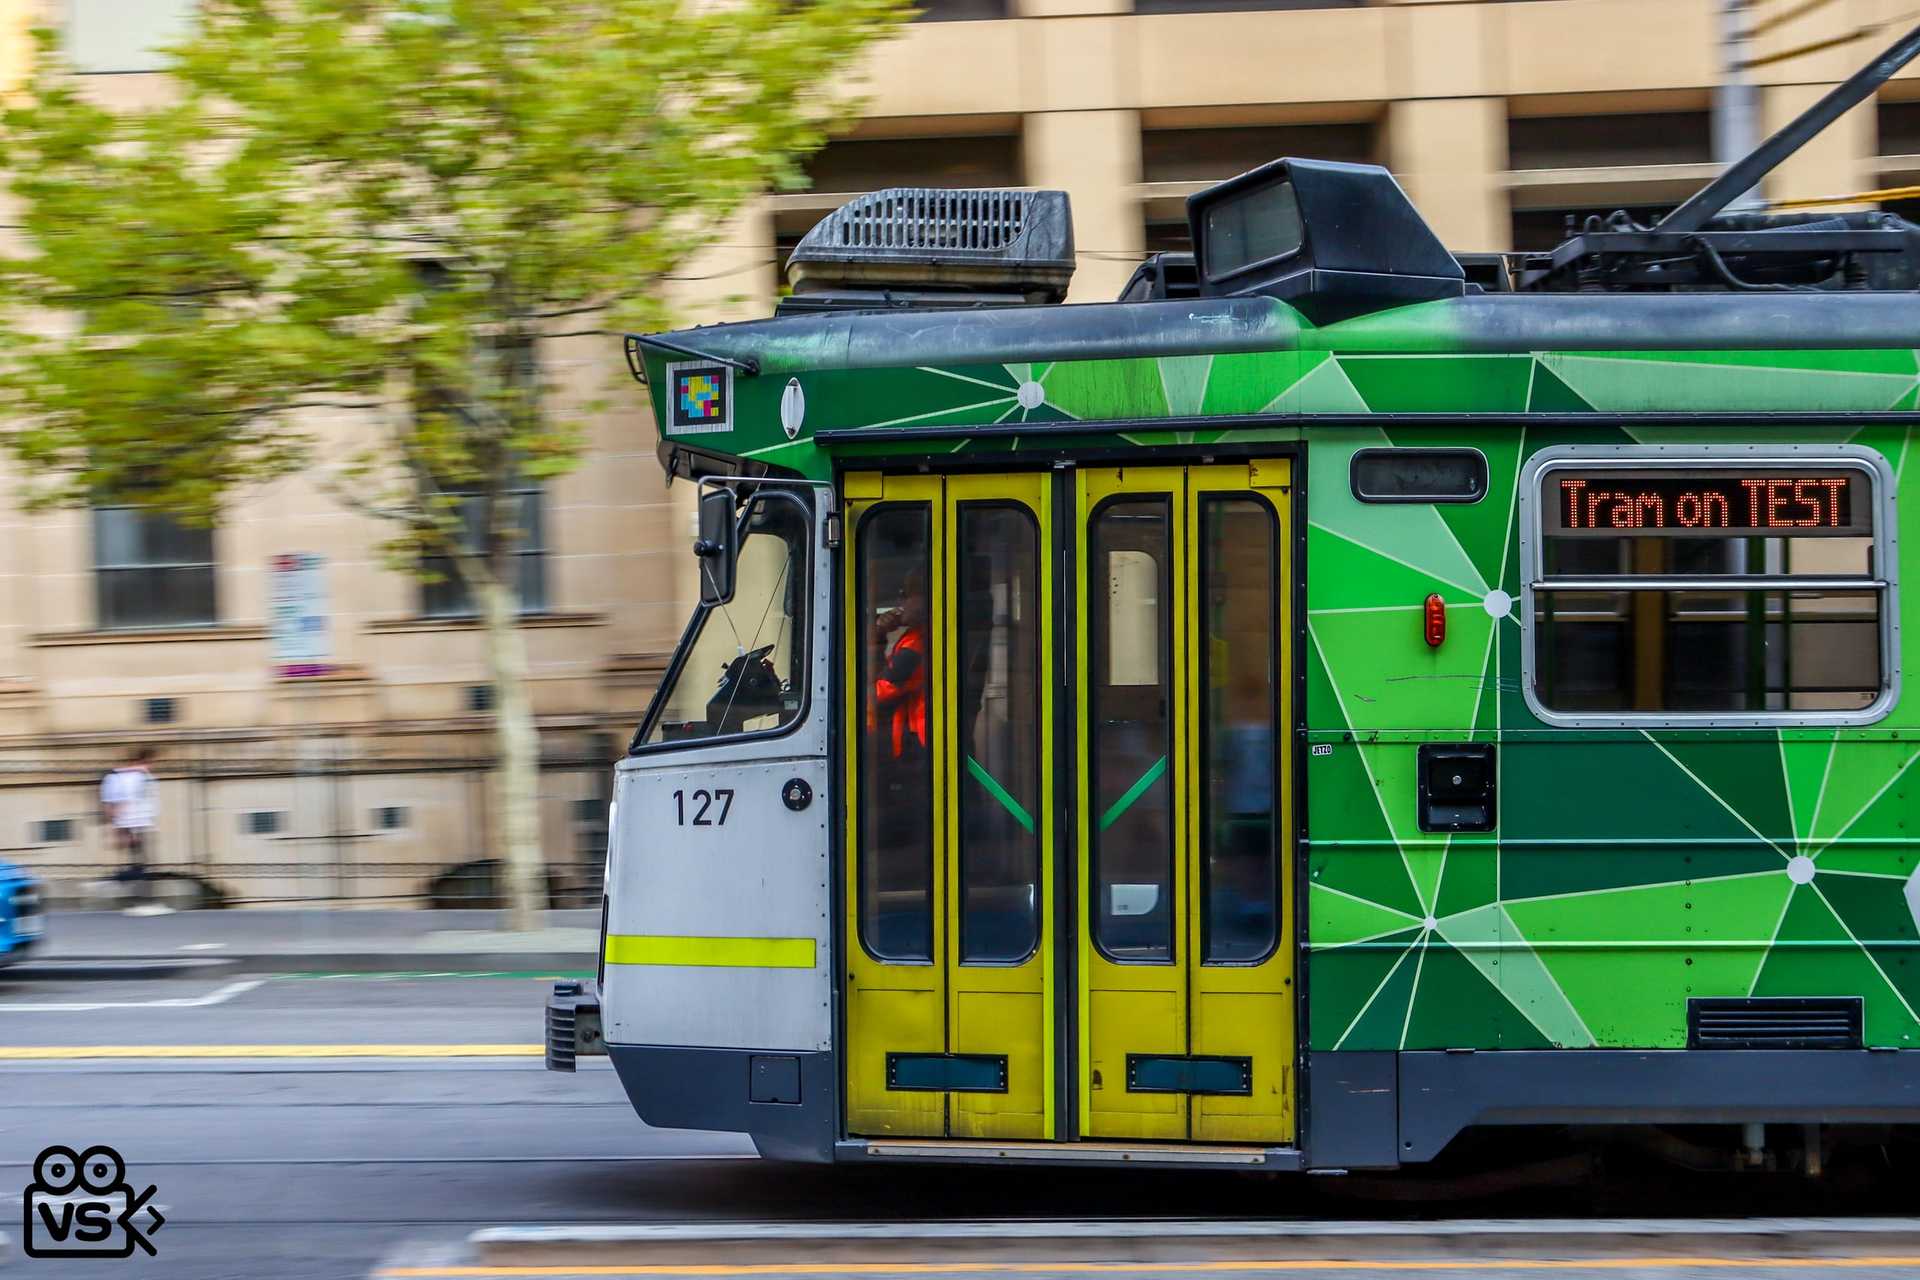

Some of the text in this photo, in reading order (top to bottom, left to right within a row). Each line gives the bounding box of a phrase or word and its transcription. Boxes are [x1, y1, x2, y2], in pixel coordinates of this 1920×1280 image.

[1561, 479, 1846, 528] Tram on TEST
[673, 789, 734, 826] 127
